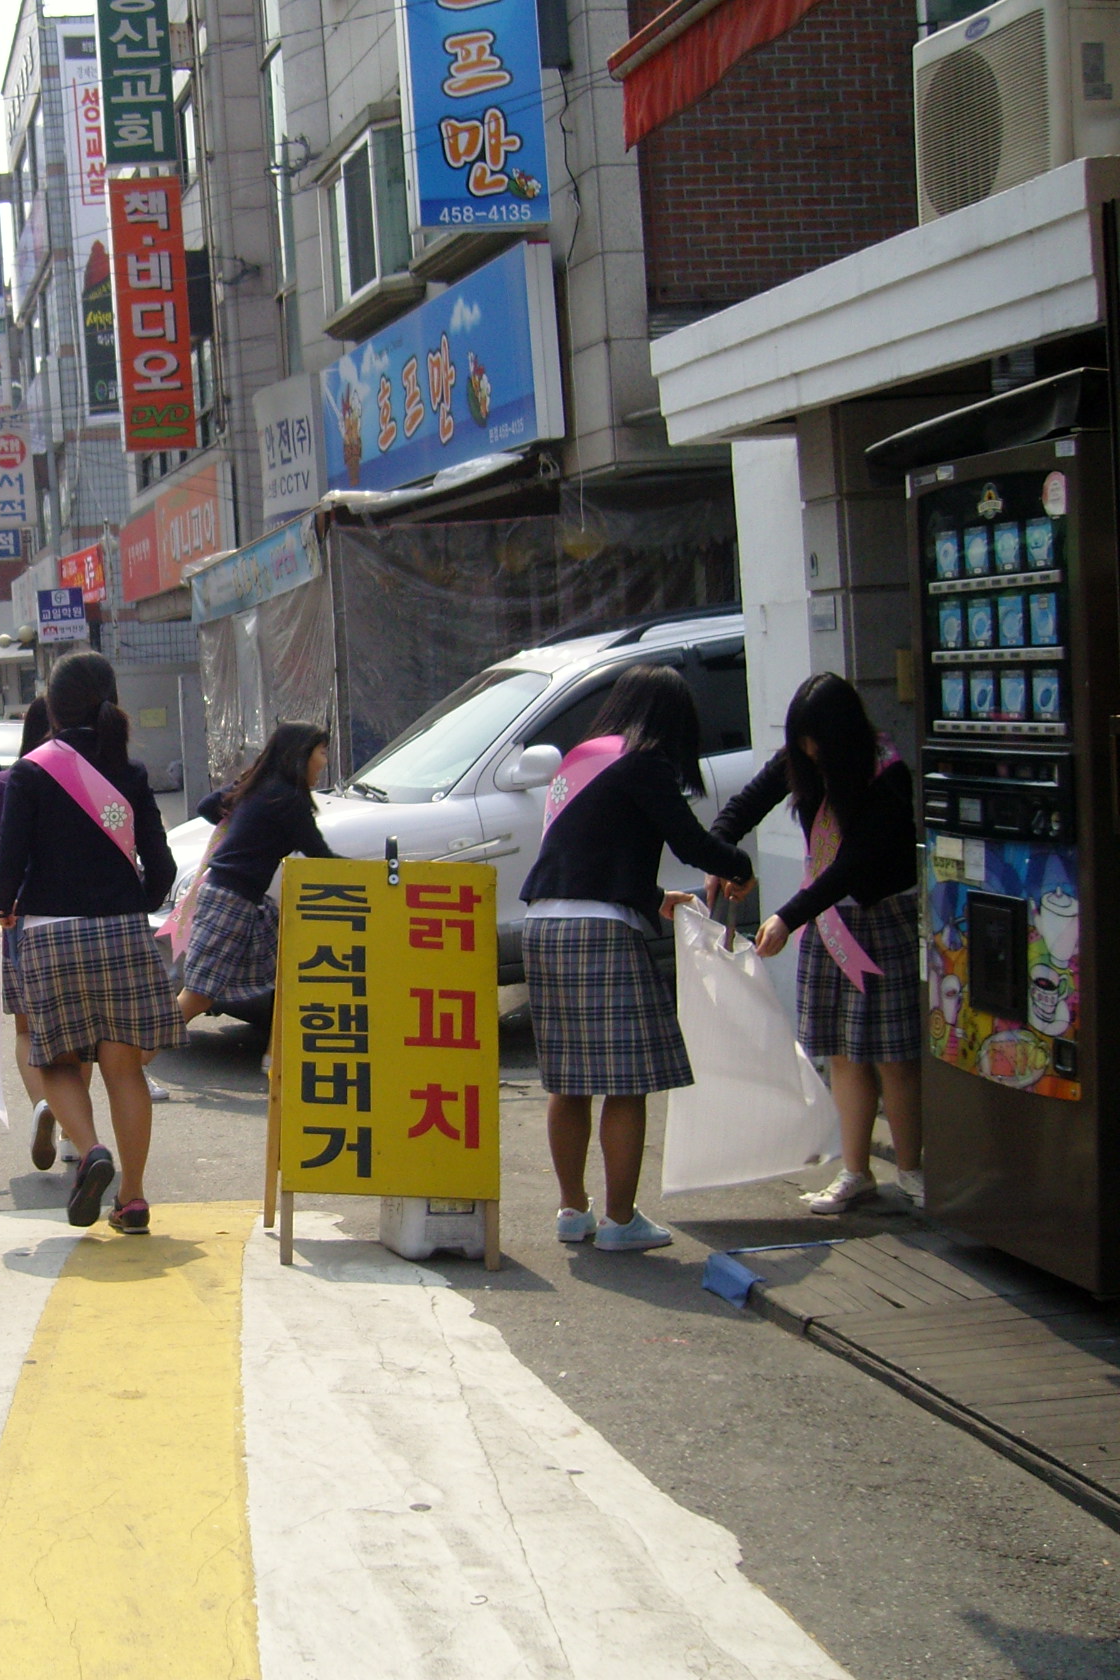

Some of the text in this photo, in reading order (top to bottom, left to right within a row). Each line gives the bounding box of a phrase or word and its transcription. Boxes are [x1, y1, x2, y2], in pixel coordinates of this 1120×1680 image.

[436, 0, 523, 197] 프만
[439, 204, 531, 223] 458-4135
[131, 404, 191, 426] DVD
[377, 332, 456, 452] 호프만
[280, 470, 310, 496] CCTV
[41, 606, 83, 620] 교일학원
[296, 883, 372, 1178] 즉석햄버거
[403, 883, 482, 1149] 닭꼬치
